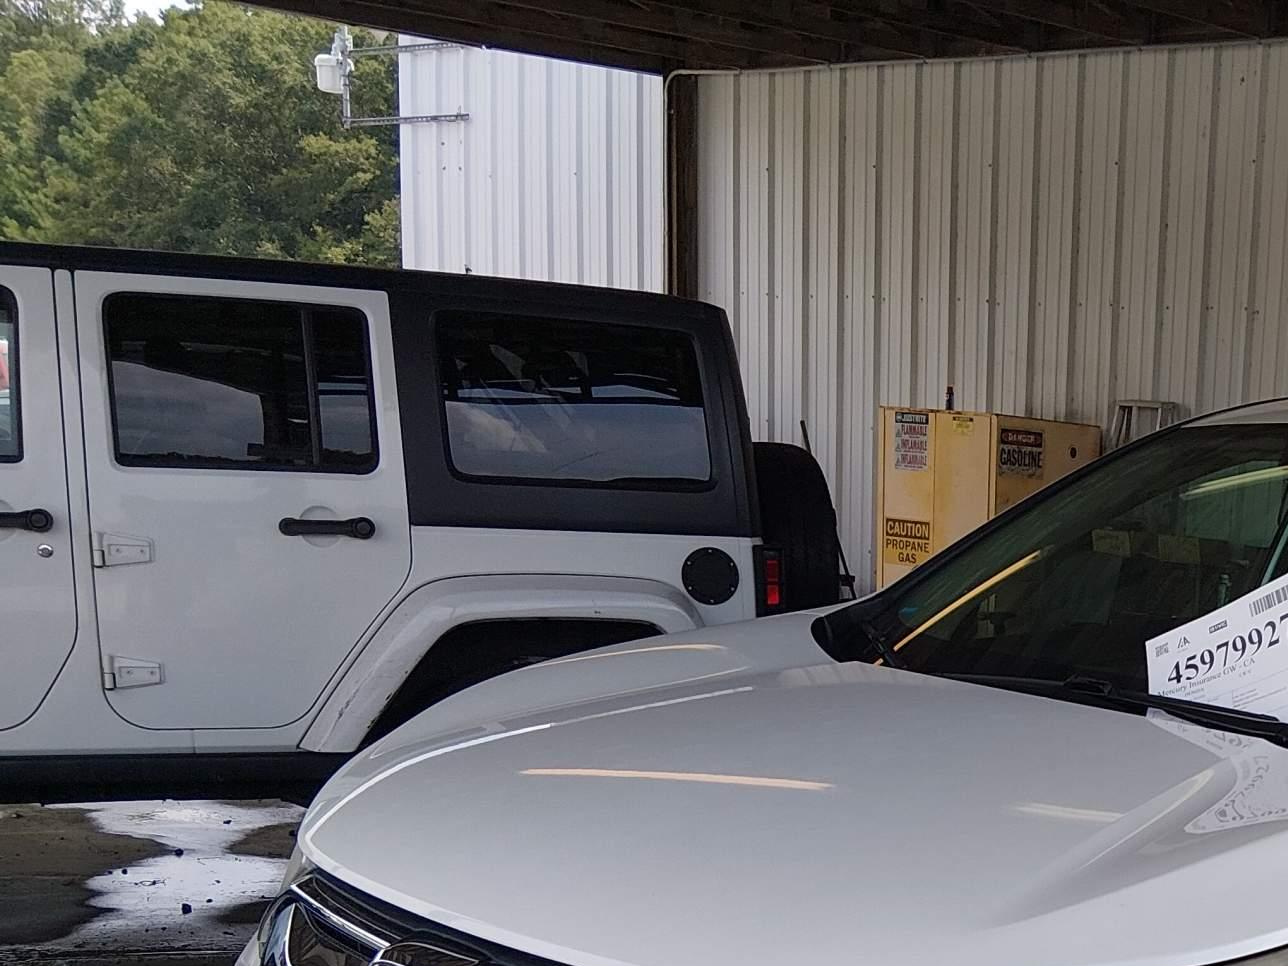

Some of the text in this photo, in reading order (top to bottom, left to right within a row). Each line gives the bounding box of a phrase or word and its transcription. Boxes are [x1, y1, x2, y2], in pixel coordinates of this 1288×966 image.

[1000, 448, 1043, 468] GASOLINE
[887, 521, 929, 538] CAUTION
[885, 538, 930, 554] PROPANE
[898, 551, 917, 564] GAS
[1157, 684, 1187, 697] Mercury
[1188, 672, 1221, 689] Insurance
[1222, 663, 1238, 676] GW
[1243, 657, 1256, 668] CA
